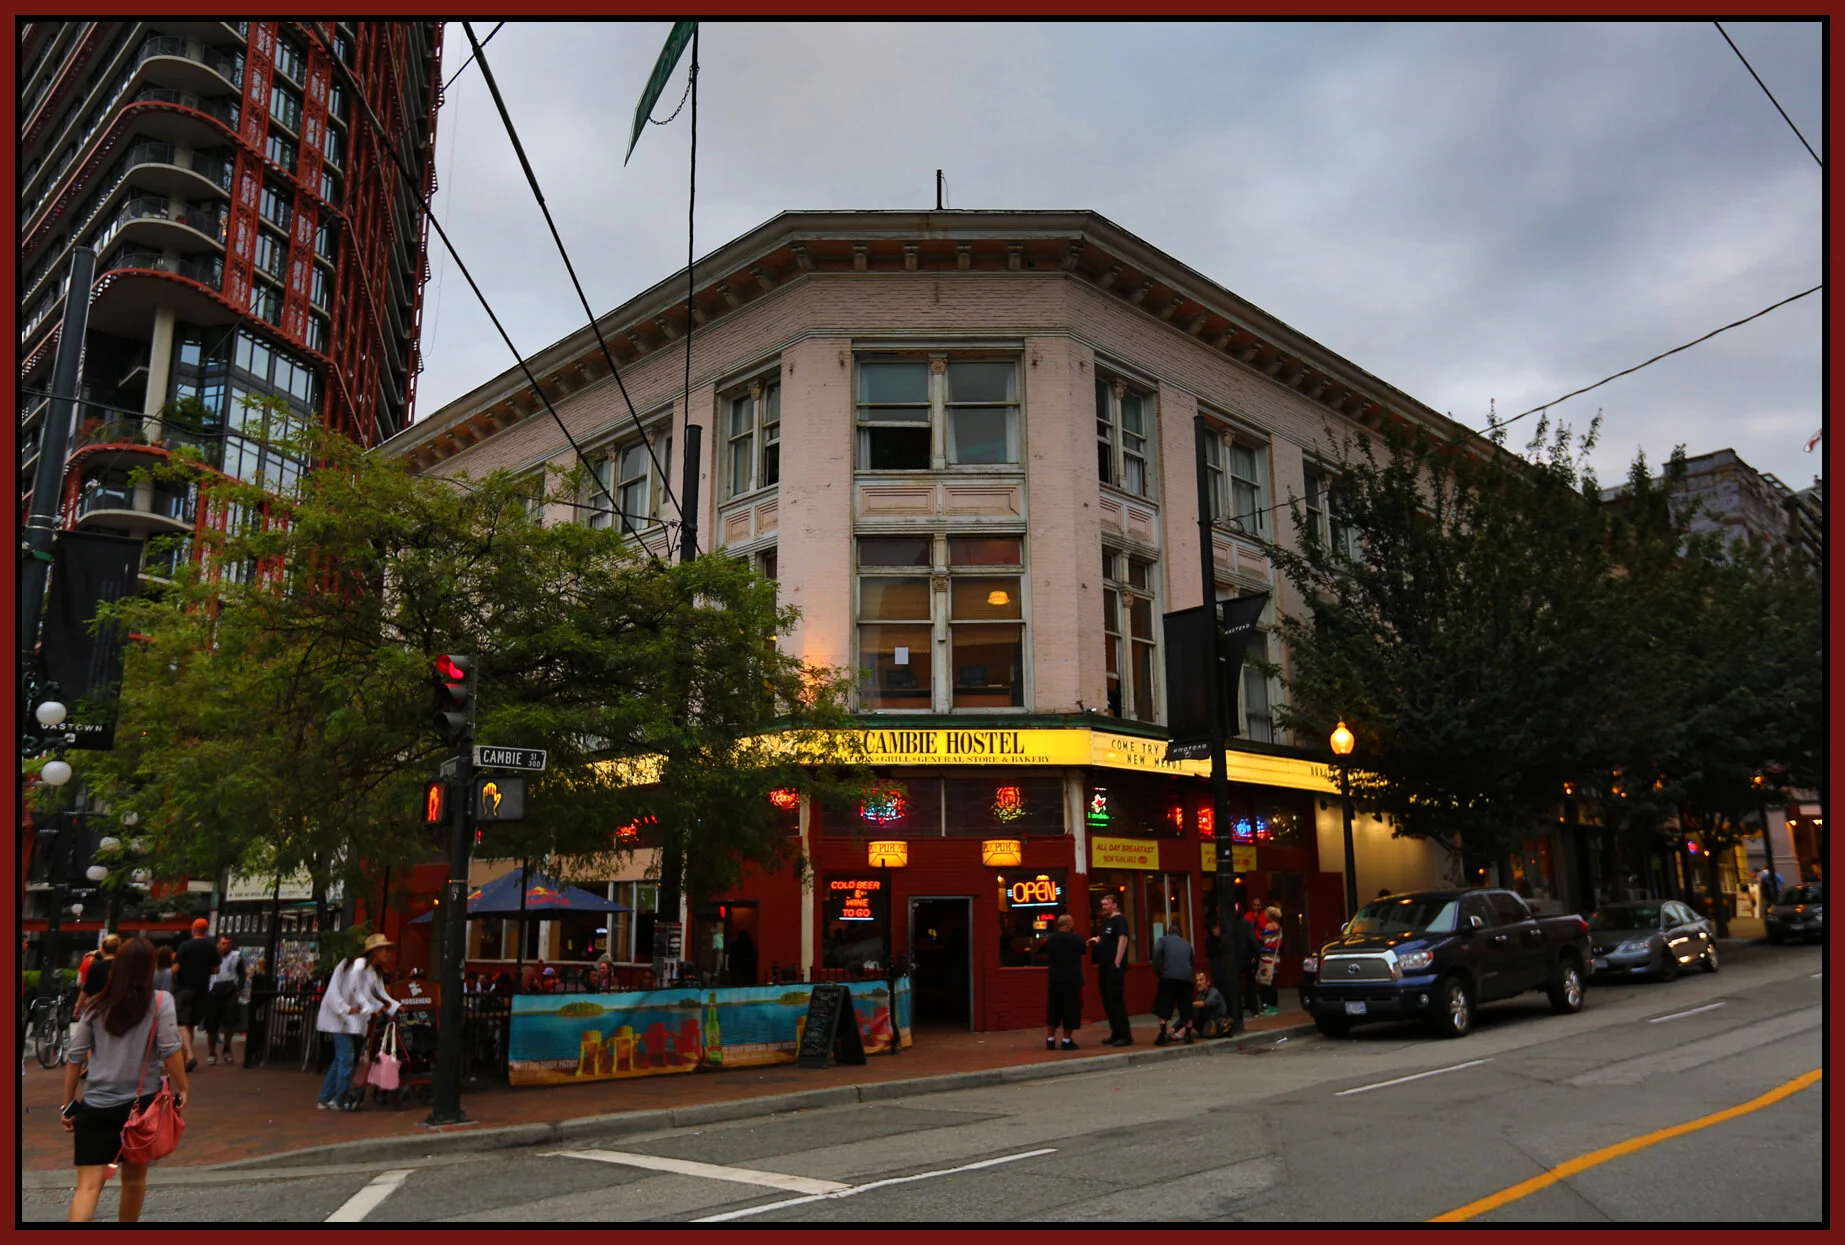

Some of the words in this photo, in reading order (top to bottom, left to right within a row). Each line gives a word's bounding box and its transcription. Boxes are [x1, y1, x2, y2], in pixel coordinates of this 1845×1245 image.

[41, 723, 103, 732] GASTOWN
[863, 732, 937, 754] CAMBIE
[946, 732, 1025, 754] HOSTEL
[1111, 740, 1135, 752] COME
[1142, 743, 1159, 755] TRY
[483, 750, 522, 765] CAMBIE
[1127, 754, 1145, 766] NEW
[1096, 843, 1108, 851] ALL
[1109, 844, 1122, 852] DAY
[1122, 845, 1155, 854] BREAKFAST
[830, 881, 855, 889] COLD
[856, 881, 881, 890] BEER
[1013, 881, 1057, 903] OPEN
[845, 898, 869, 907] WINE
[842, 909, 855, 917] TO
[855, 909, 871, 917] GO
